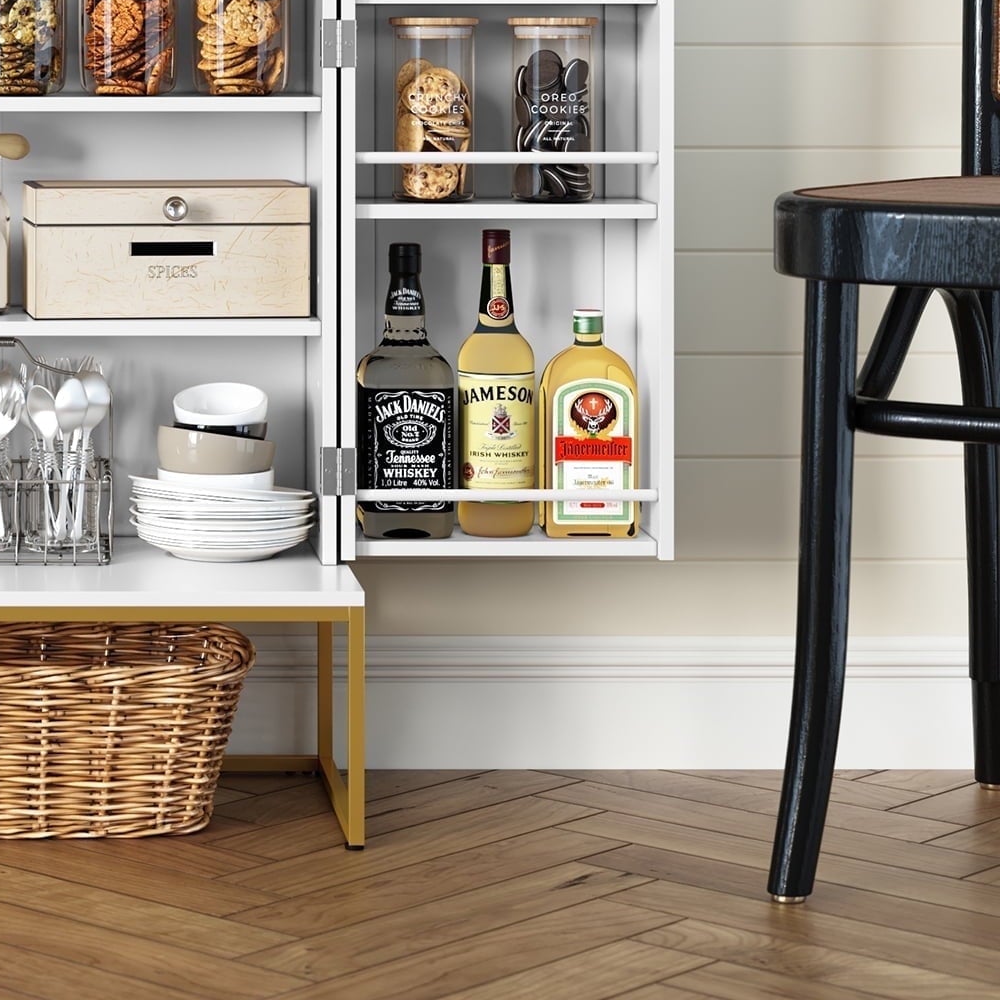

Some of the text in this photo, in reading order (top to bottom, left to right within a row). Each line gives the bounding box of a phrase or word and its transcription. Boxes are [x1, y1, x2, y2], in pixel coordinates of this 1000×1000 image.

[541, 93, 577, 102] OREO
[411, 105, 464, 114] COOKIES
[531, 105, 585, 114] COOKIES
[148, 265, 198, 279] SPICES
[463, 386, 534, 405] JAMESON
[375, 394, 446, 423] JACK DANIEL'S
[385, 450, 436, 464] Tennessee
[469, 450, 530, 459] IRISH WHISKEY
[383, 468, 438, 478] WHISKEY
[393, 479, 408, 487] Litre
